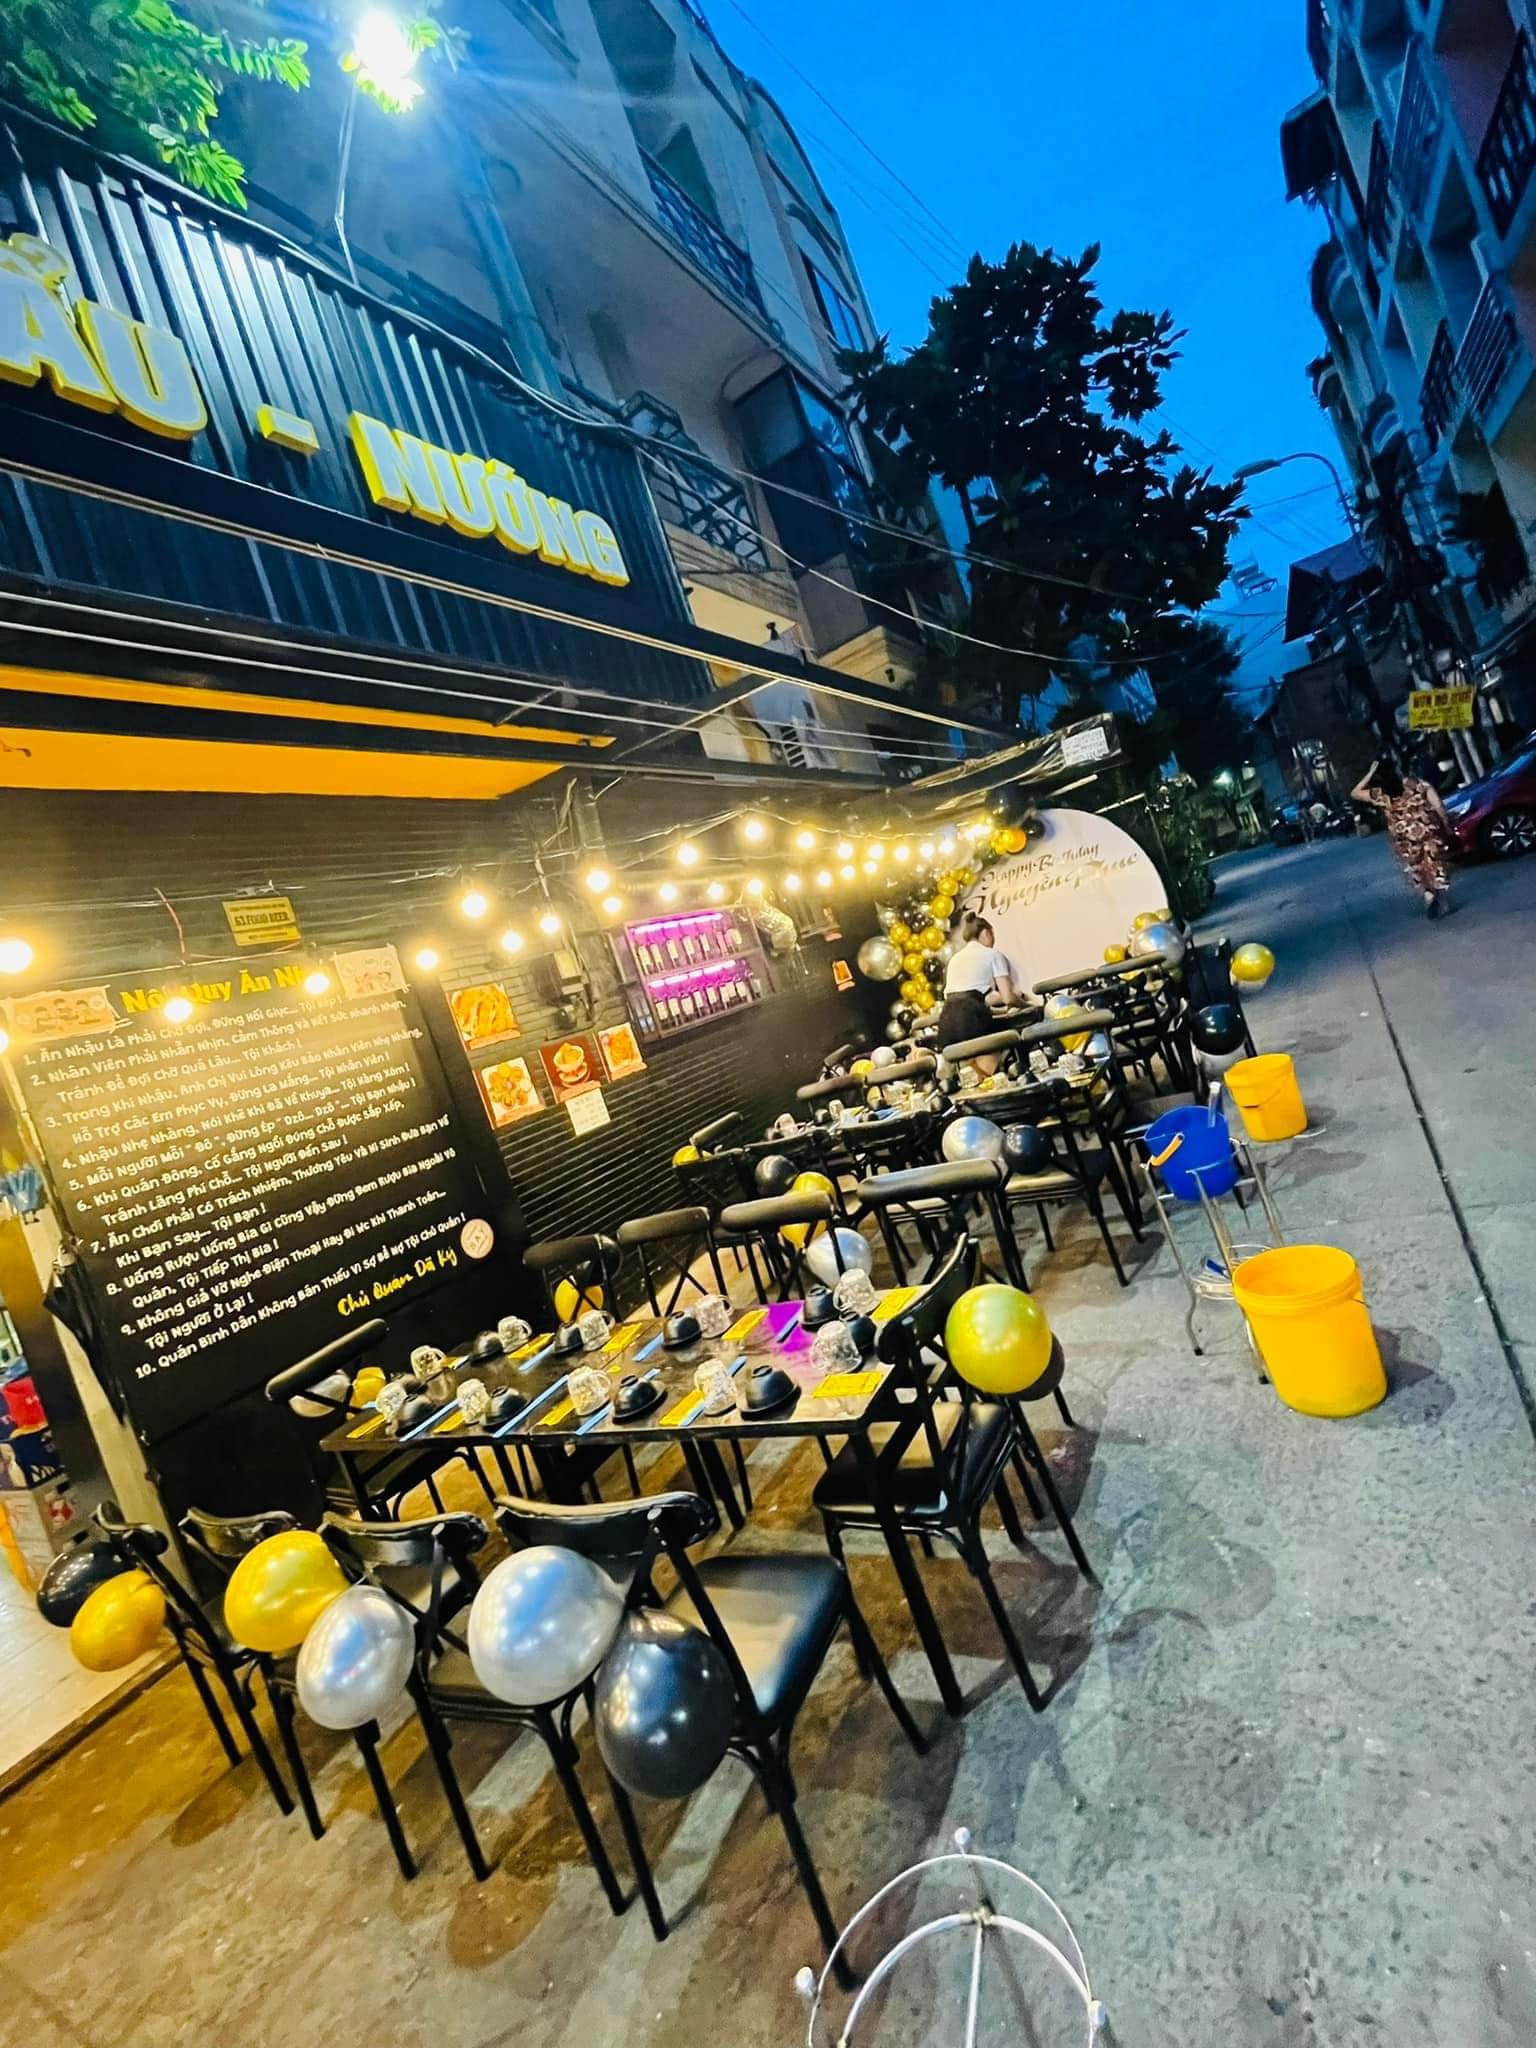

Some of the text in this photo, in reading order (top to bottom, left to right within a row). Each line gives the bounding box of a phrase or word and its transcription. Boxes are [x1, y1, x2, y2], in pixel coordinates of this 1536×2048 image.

[257, 404, 320, 455] -
[348, 410, 630, 588] NƯỚNG
[981, 844, 1100, 891] Happy Bthday
[239, 969, 271, 994] Ăn
[23, 1008, 263, 1064] 1. Ăn Nhậu Là Phải Đừng Hối
[30, 1024, 293, 1085] 2. Nhân Viên Phải Cảm Thông
[56, 1040, 294, 1102] Tránh Để Đợi Chờ Quá Tội Khách
[45, 1064, 277, 1127] 3. Trong Khi Nhậu, Anh Chị Vui Lòng
[62, 1066, 404, 1168] 4. Nhậu Nhẹ Nhàng, Nói Khẽ Khi Đã Tội Hàng Xóm
[72, 1054, 384, 1143] Hỗ Trợ Các Em Phục Vụ, Đừng La Tội Nhân Viên
[69, 1088, 386, 1190] 5. Mỗi Người Mỗi Đừng Ép Tội Bạn
[77, 1098, 404, 1210] 6. Khi Quán Đông, Cố Gắng Đúng Chỗ Được Sắp Xếp,
[90, 1122, 437, 1253] 7. Ăn Chơi Phải Có Trách Nhiệm, Thương Yêu Và Sinh Đưa Bạn
[101, 1139, 340, 1225] Tránh Lãng Phí Tội Người Đến Sau
[106, 1147, 455, 1294] 8. Uống Rượu Uống Bia Cũng Vậy Đừng Đem Rượu Bia Ngoài Vô
[116, 1207, 259, 1267] Khi Bạn Tội Bạn
[121, 1200, 415, 1335] 9. Không Giả Vờ Nghe Điện Thoại Hay Đi Khi Thanh
[132, 1244, 271, 1307] Quán, Tội Tiếp Thị Bia
[135, 1215, 460, 1378] 10. Quán Bình Dân Không Bán Thiếu Sợ Nợ Tội Chủ Quán
[338, 1290, 369, 1315] Chủ
[145, 1295, 245, 1349] Tội Người Lại
